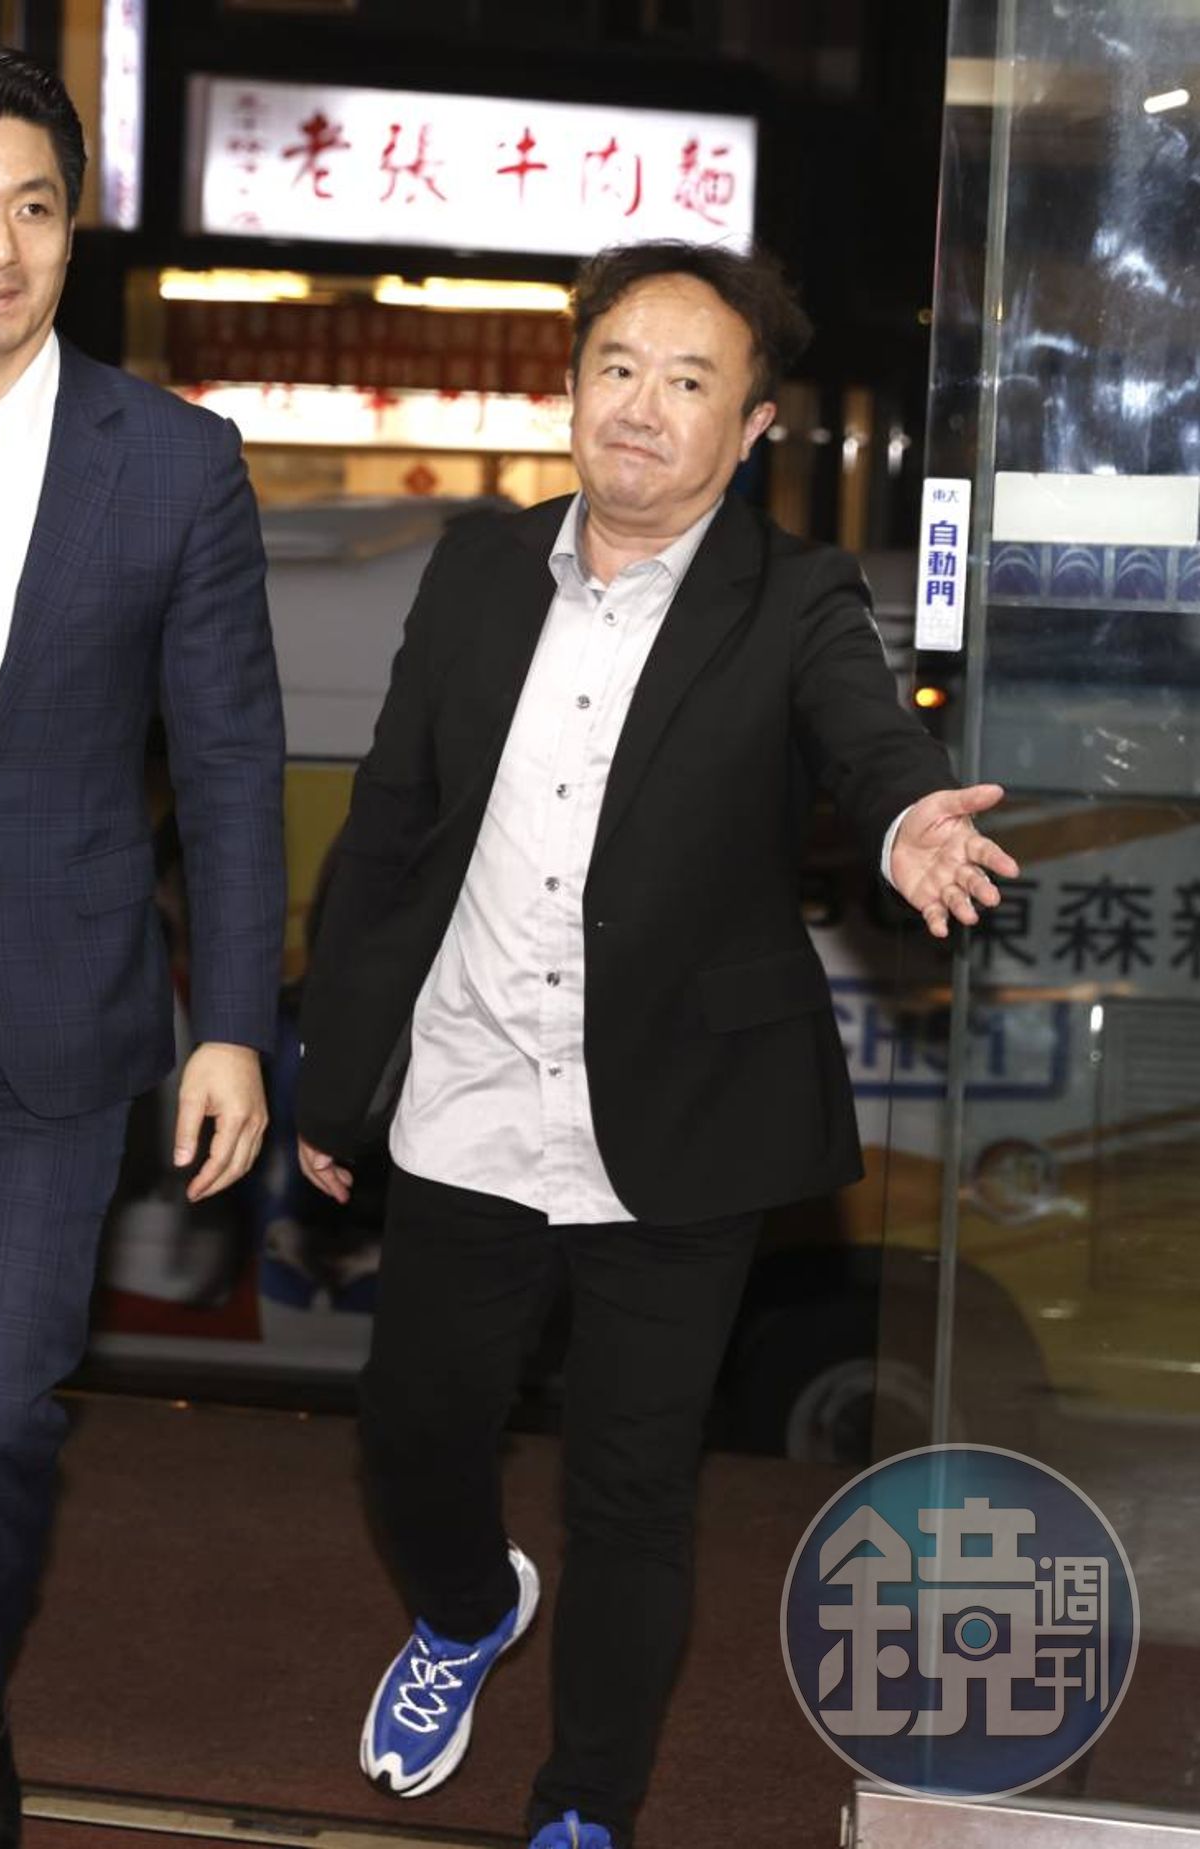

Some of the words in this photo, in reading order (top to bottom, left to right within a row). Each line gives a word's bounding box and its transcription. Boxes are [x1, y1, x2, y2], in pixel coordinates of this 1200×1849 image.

[282, 112, 737, 228] 老張牛肉麵
[925, 519, 958, 607] 自動門
[969, 874, 1200, 980] 東森
